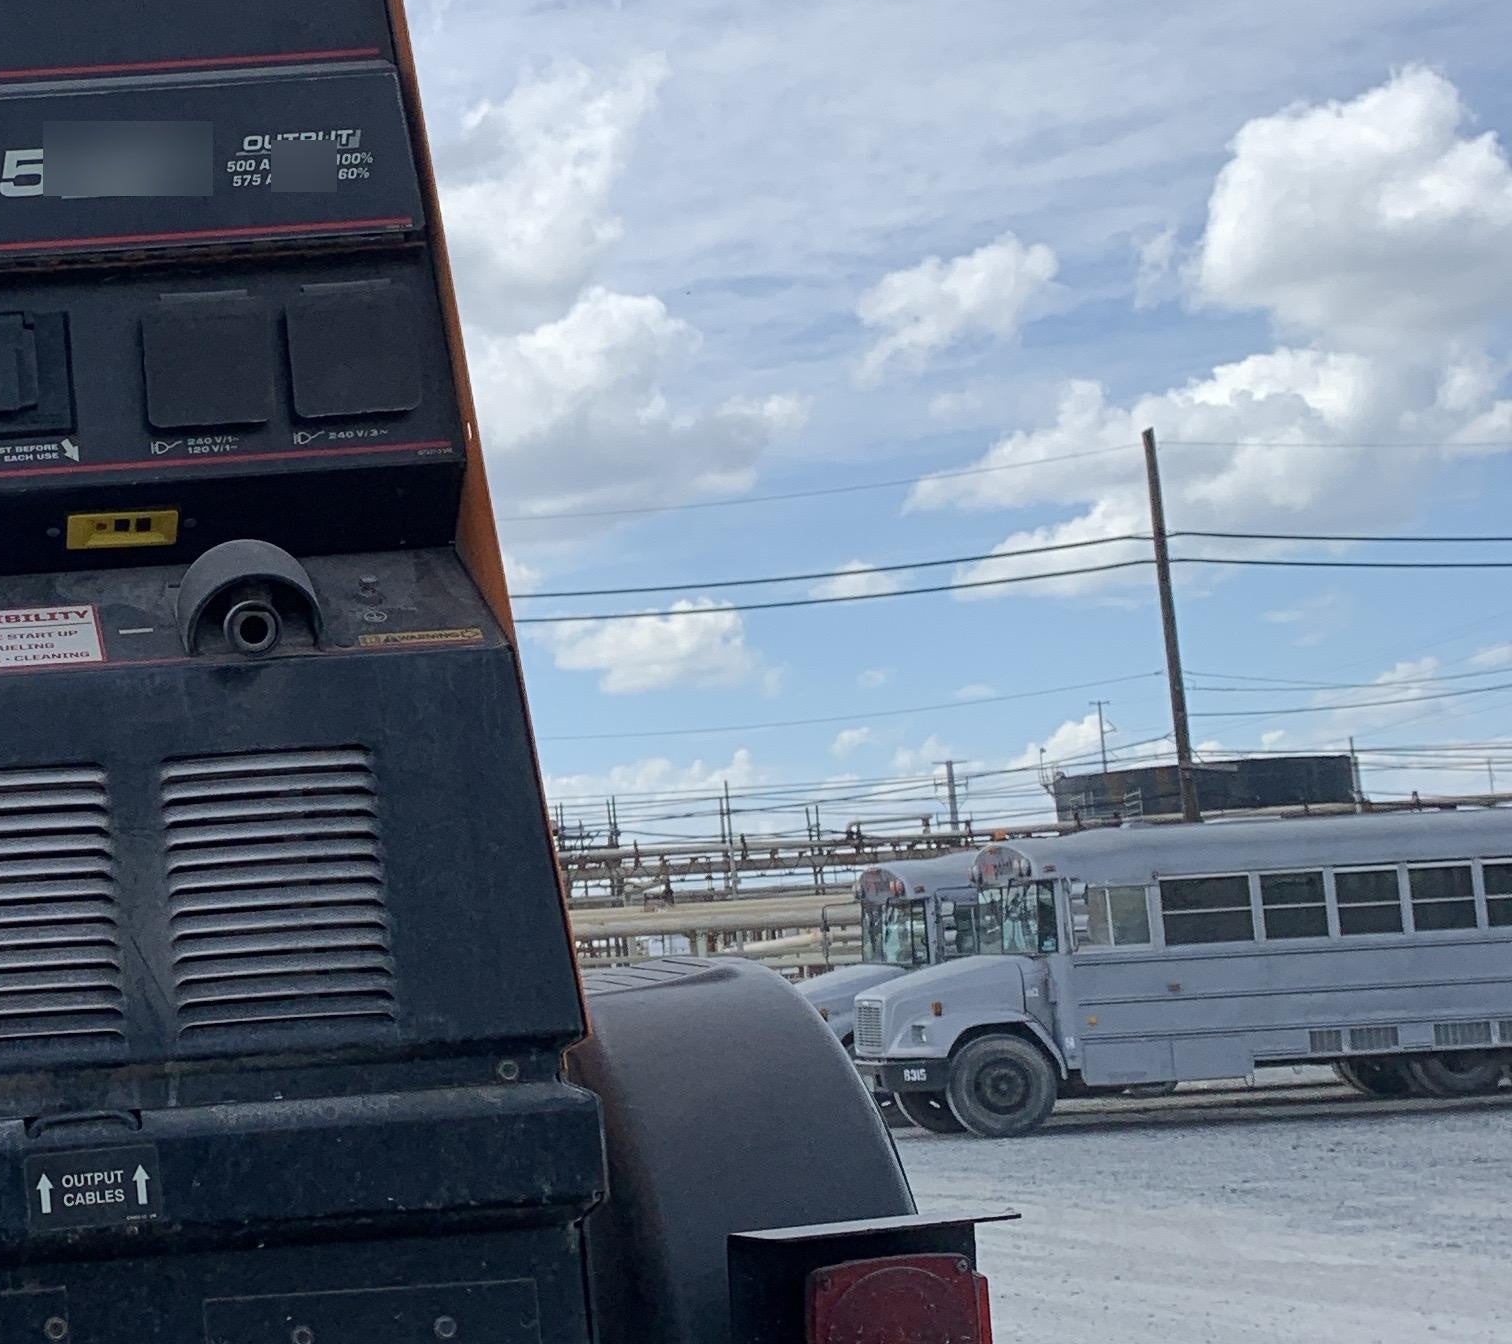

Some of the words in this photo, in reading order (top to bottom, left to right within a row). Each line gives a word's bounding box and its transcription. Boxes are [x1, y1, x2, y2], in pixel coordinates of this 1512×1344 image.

[226, 159, 256, 173] 500
[338, 167, 370, 180] 60%
[232, 173, 262, 187] 575
[328, 430, 354, 439] 240
[187, 436, 212, 446] 240
[14, 443, 59, 454] BEFORE
[187, 445, 211, 454] 120
[4, 453, 35, 462] EACH
[36, 451, 60, 460] USE
[7, 631, 54, 641] START
[57, 629, 79, 638] UP
[13, 650, 91, 662] CLEANING
[62, 1170, 125, 1189] OUTPUT
[63, 1188, 126, 1207] CABLES
